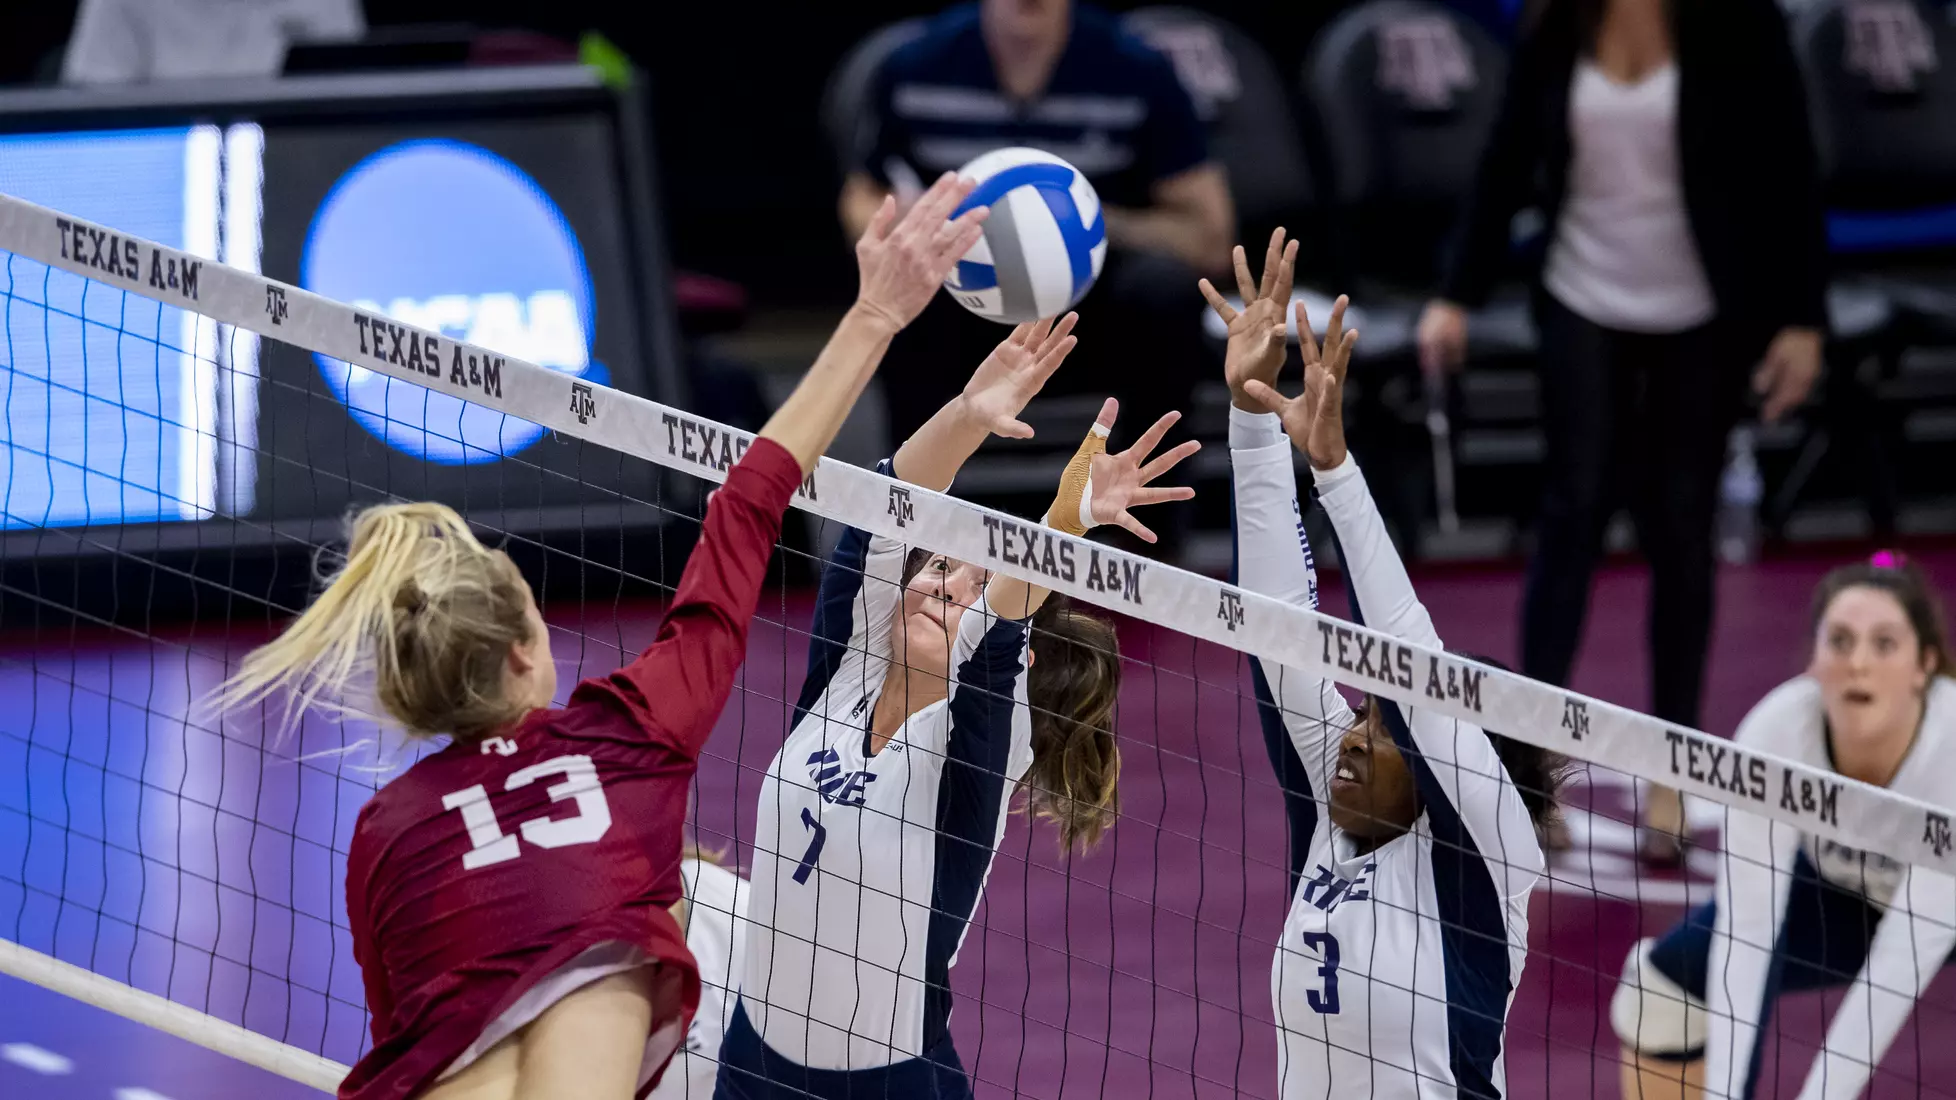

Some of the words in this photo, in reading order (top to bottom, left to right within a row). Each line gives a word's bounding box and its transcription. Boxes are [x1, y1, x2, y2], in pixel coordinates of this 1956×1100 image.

[56, 217, 139, 282] TEXAS
[149, 249, 202, 301] A&M
[353, 312, 441, 378] TEXAS
[449, 345, 505, 399] A&M
[983, 515, 1076, 583] TEXAS
[1086, 548, 1147, 605] A&M
[1317, 620, 1413, 690] TEXAS
[1424, 655, 1488, 712] A&M
[442, 754, 613, 871] 13
[1665, 729, 1767, 803] TEXAS
[1779, 769, 1845, 828] A&M
[1303, 931, 1341, 1015] 3
